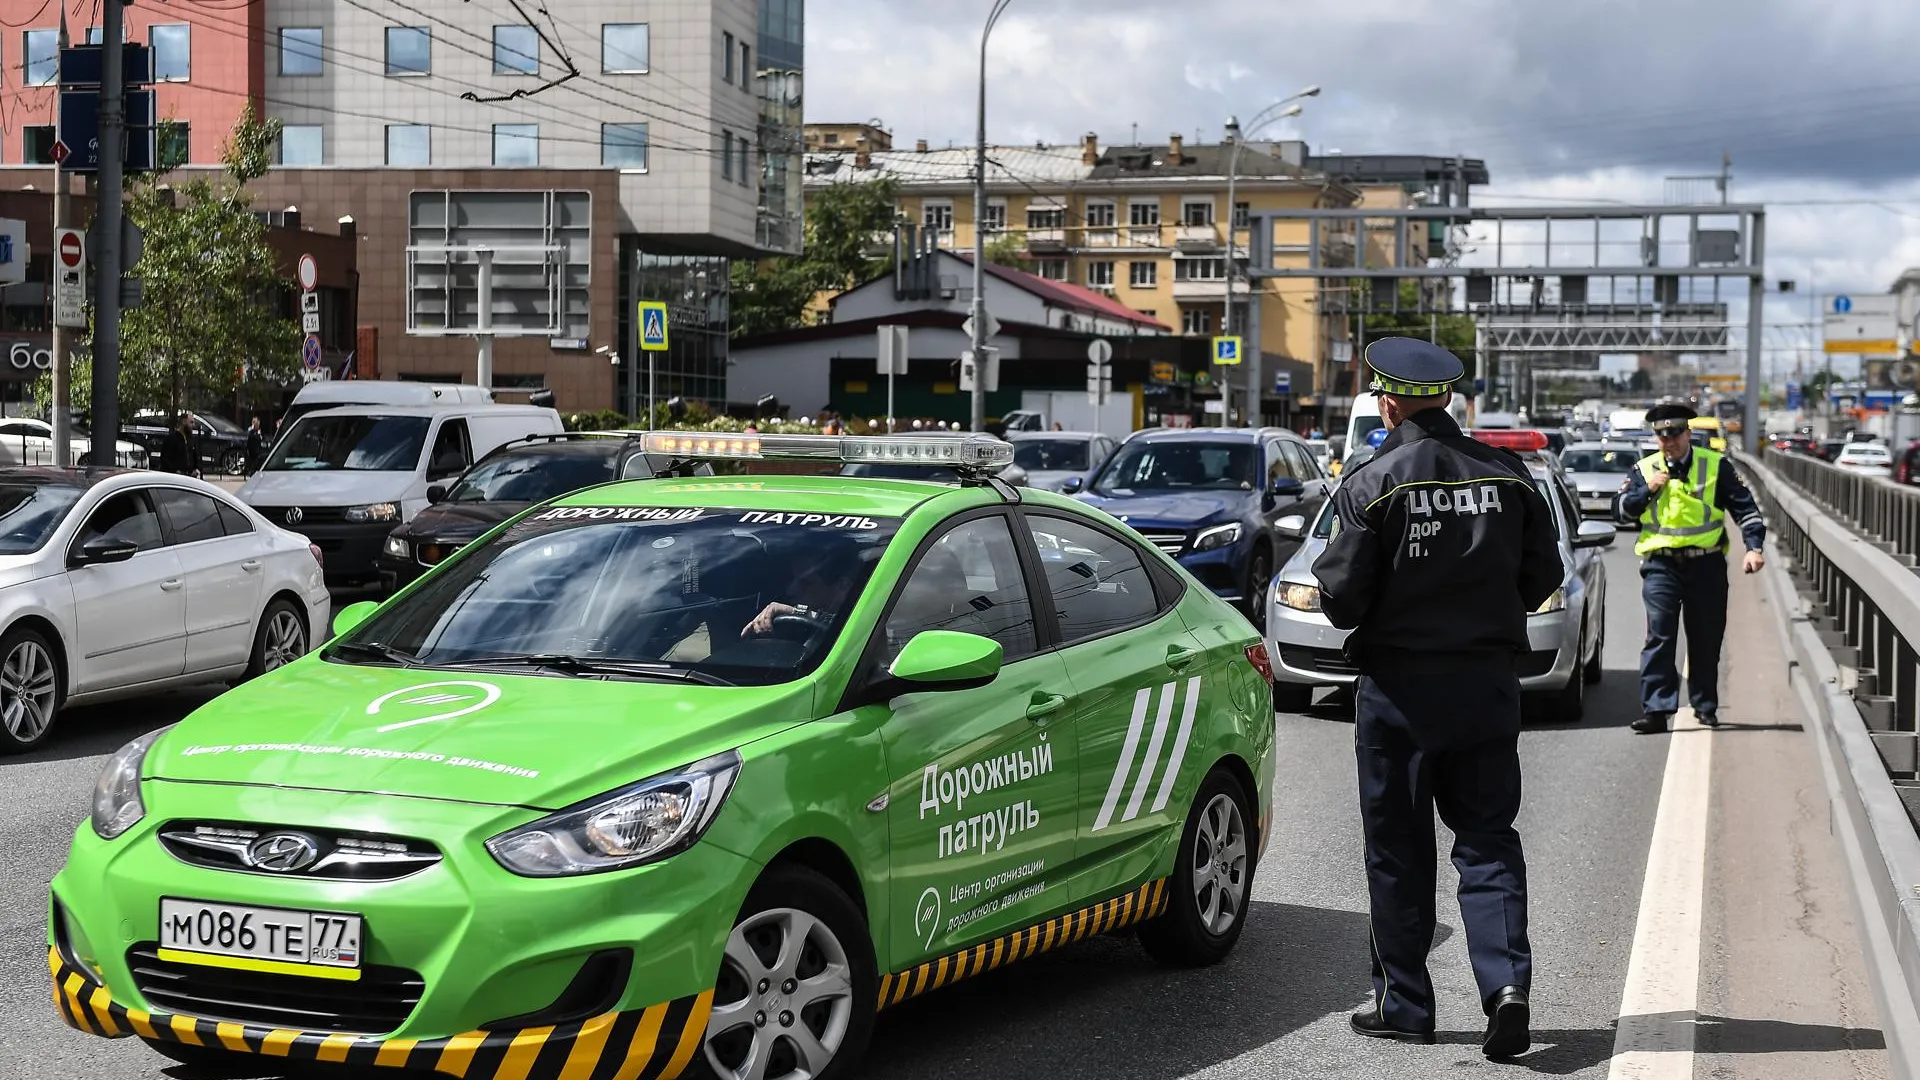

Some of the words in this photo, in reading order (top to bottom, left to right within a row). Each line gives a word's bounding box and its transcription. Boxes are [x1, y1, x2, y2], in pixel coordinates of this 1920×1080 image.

[1408, 485, 1502, 517] ЦОДД
[533, 507, 705, 520] ДОРОЖНЫЙ
[739, 511, 878, 529] ПАТРУЛЬ
[1409, 521, 1442, 540] ДОР
[345, 747, 445, 761] дорожного
[445, 756, 540, 779] движения
[920, 732, 1053, 820] Дорожный
[938, 800, 1040, 859] патруль
[950, 881, 981, 903] Центр
[985, 858, 1045, 889] организации
[947, 899, 998, 933] дорожного
[1001, 880, 1046, 911] движения
[314, 917, 347, 948] 77
[312, 947, 337, 960] RUS
